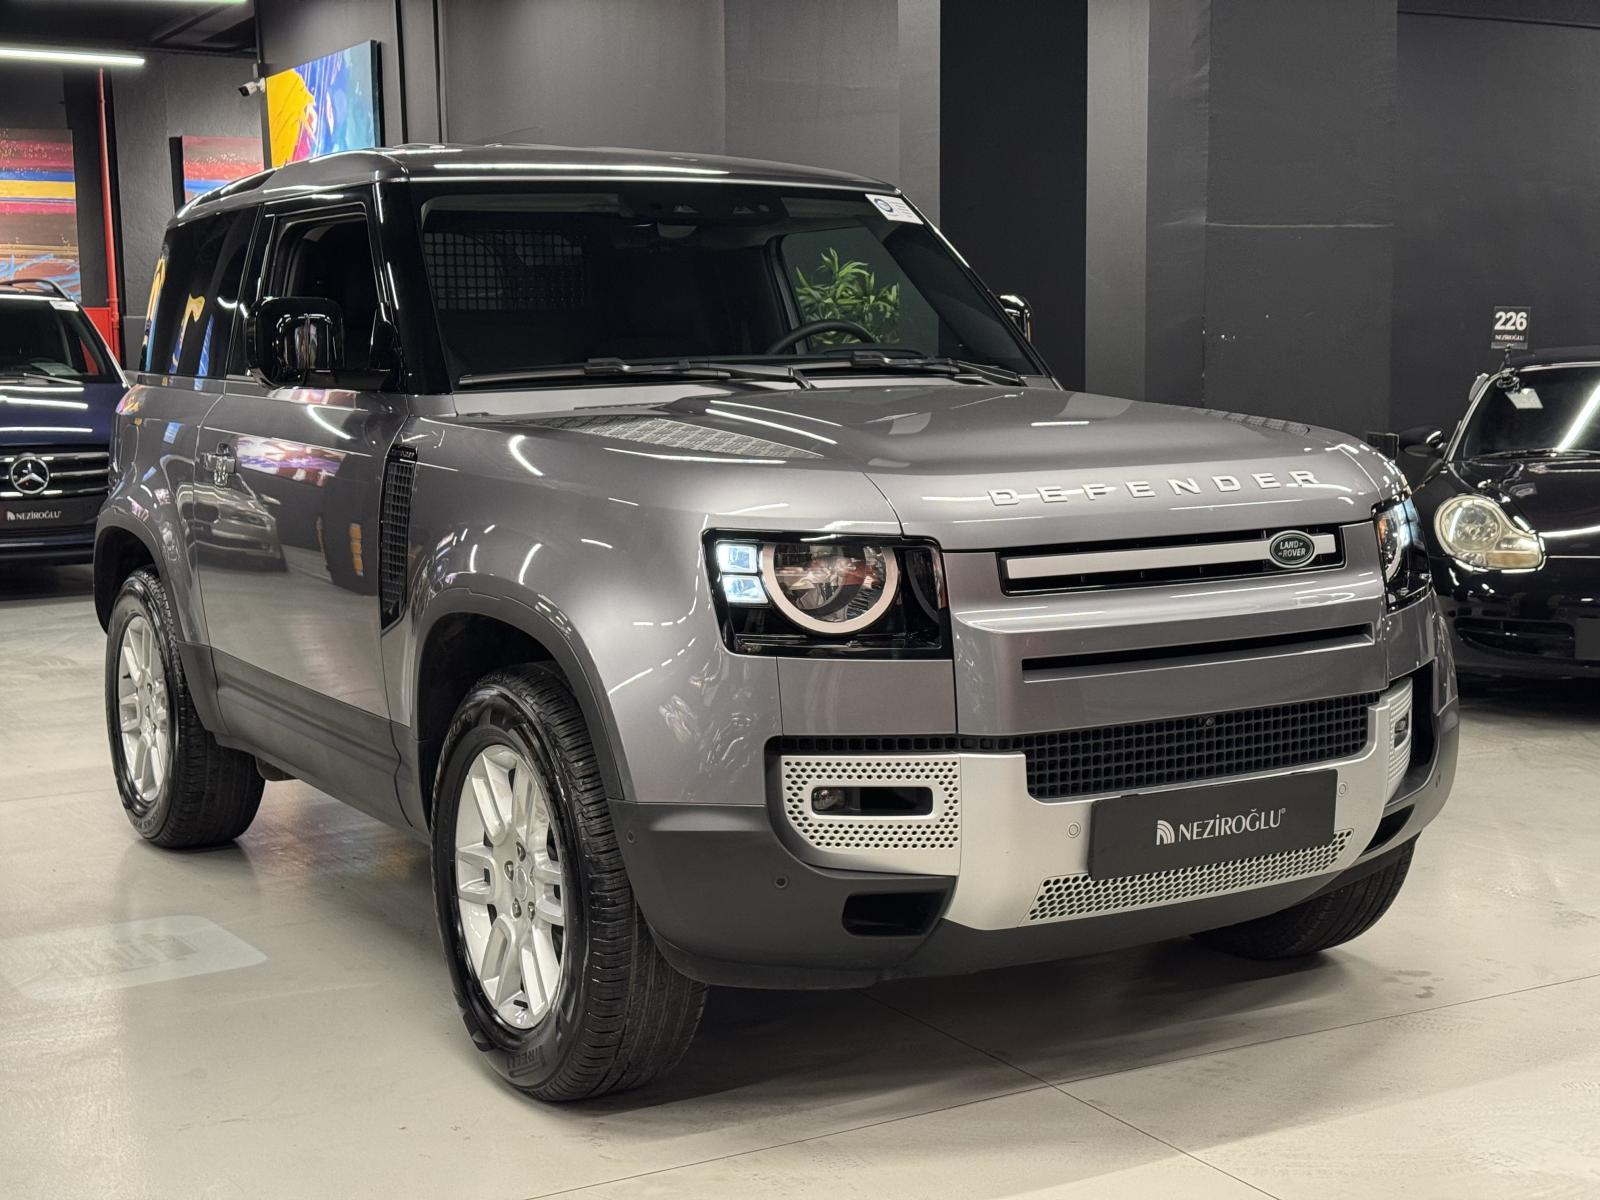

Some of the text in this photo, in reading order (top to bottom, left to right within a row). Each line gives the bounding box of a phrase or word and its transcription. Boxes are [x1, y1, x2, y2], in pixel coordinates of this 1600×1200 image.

[1494, 311, 1528, 331] 226
[987, 470, 1320, 506] DEFENDER
[1178, 808, 1282, 842] NEZİROĞLU
